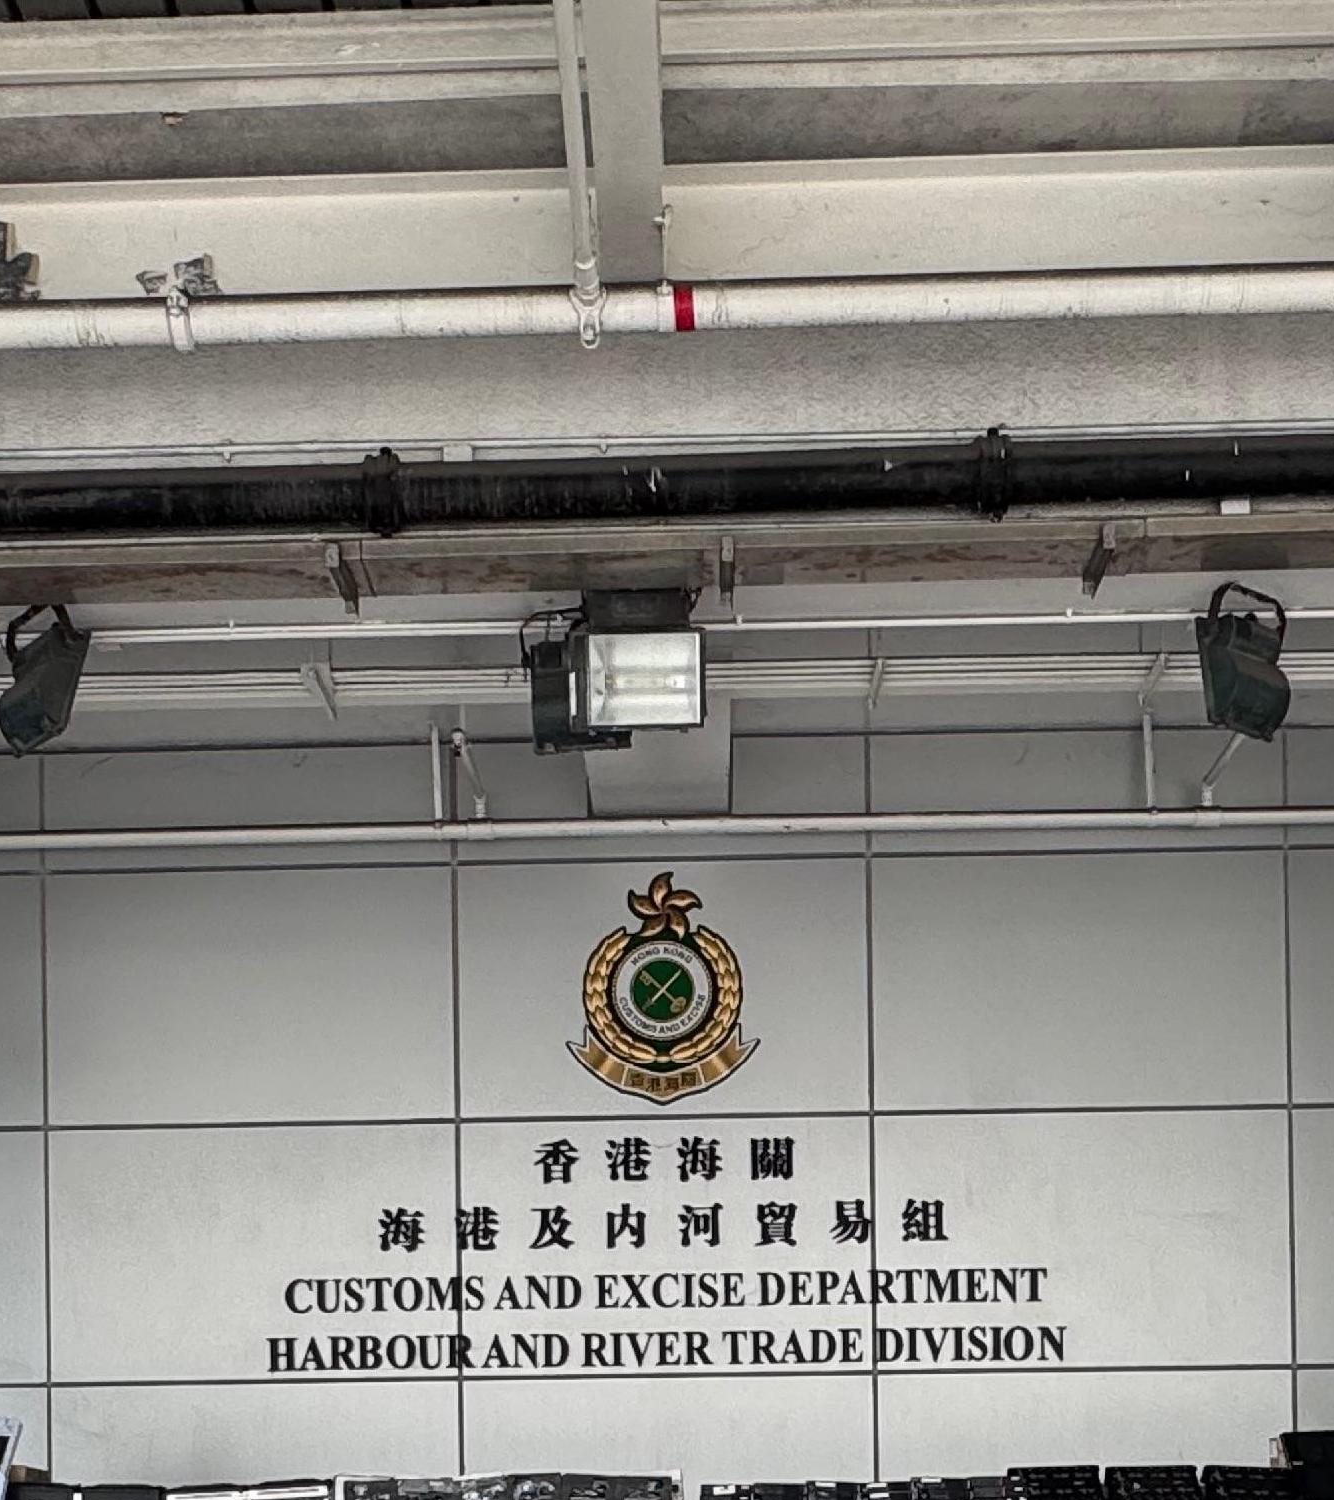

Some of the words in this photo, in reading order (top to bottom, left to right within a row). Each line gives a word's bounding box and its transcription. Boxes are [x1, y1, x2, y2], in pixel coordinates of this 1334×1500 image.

[631, 946, 661, 966] HONG
[663, 946, 693, 965] KONG
[619, 996, 658, 1034] CUSTOMS
[658, 1022, 681, 1034] AND
[679, 993, 707, 1027] EXCISE
[533, 1136, 796, 1184] 香港海關
[284, 1274, 486, 1314] CUSTOMS
[493, 1274, 582, 1310] AND
[594, 1271, 746, 1310] EXCISE
[756, 1267, 1048, 1307] DEPARTMENT
[266, 1333, 476, 1373] HARBOUR
[480, 1332, 570, 1369] AND
[580, 1331, 714, 1368] RIVER
[722, 1328, 864, 1365] TRADE
[874, 1325, 1067, 1363] DIVISION
